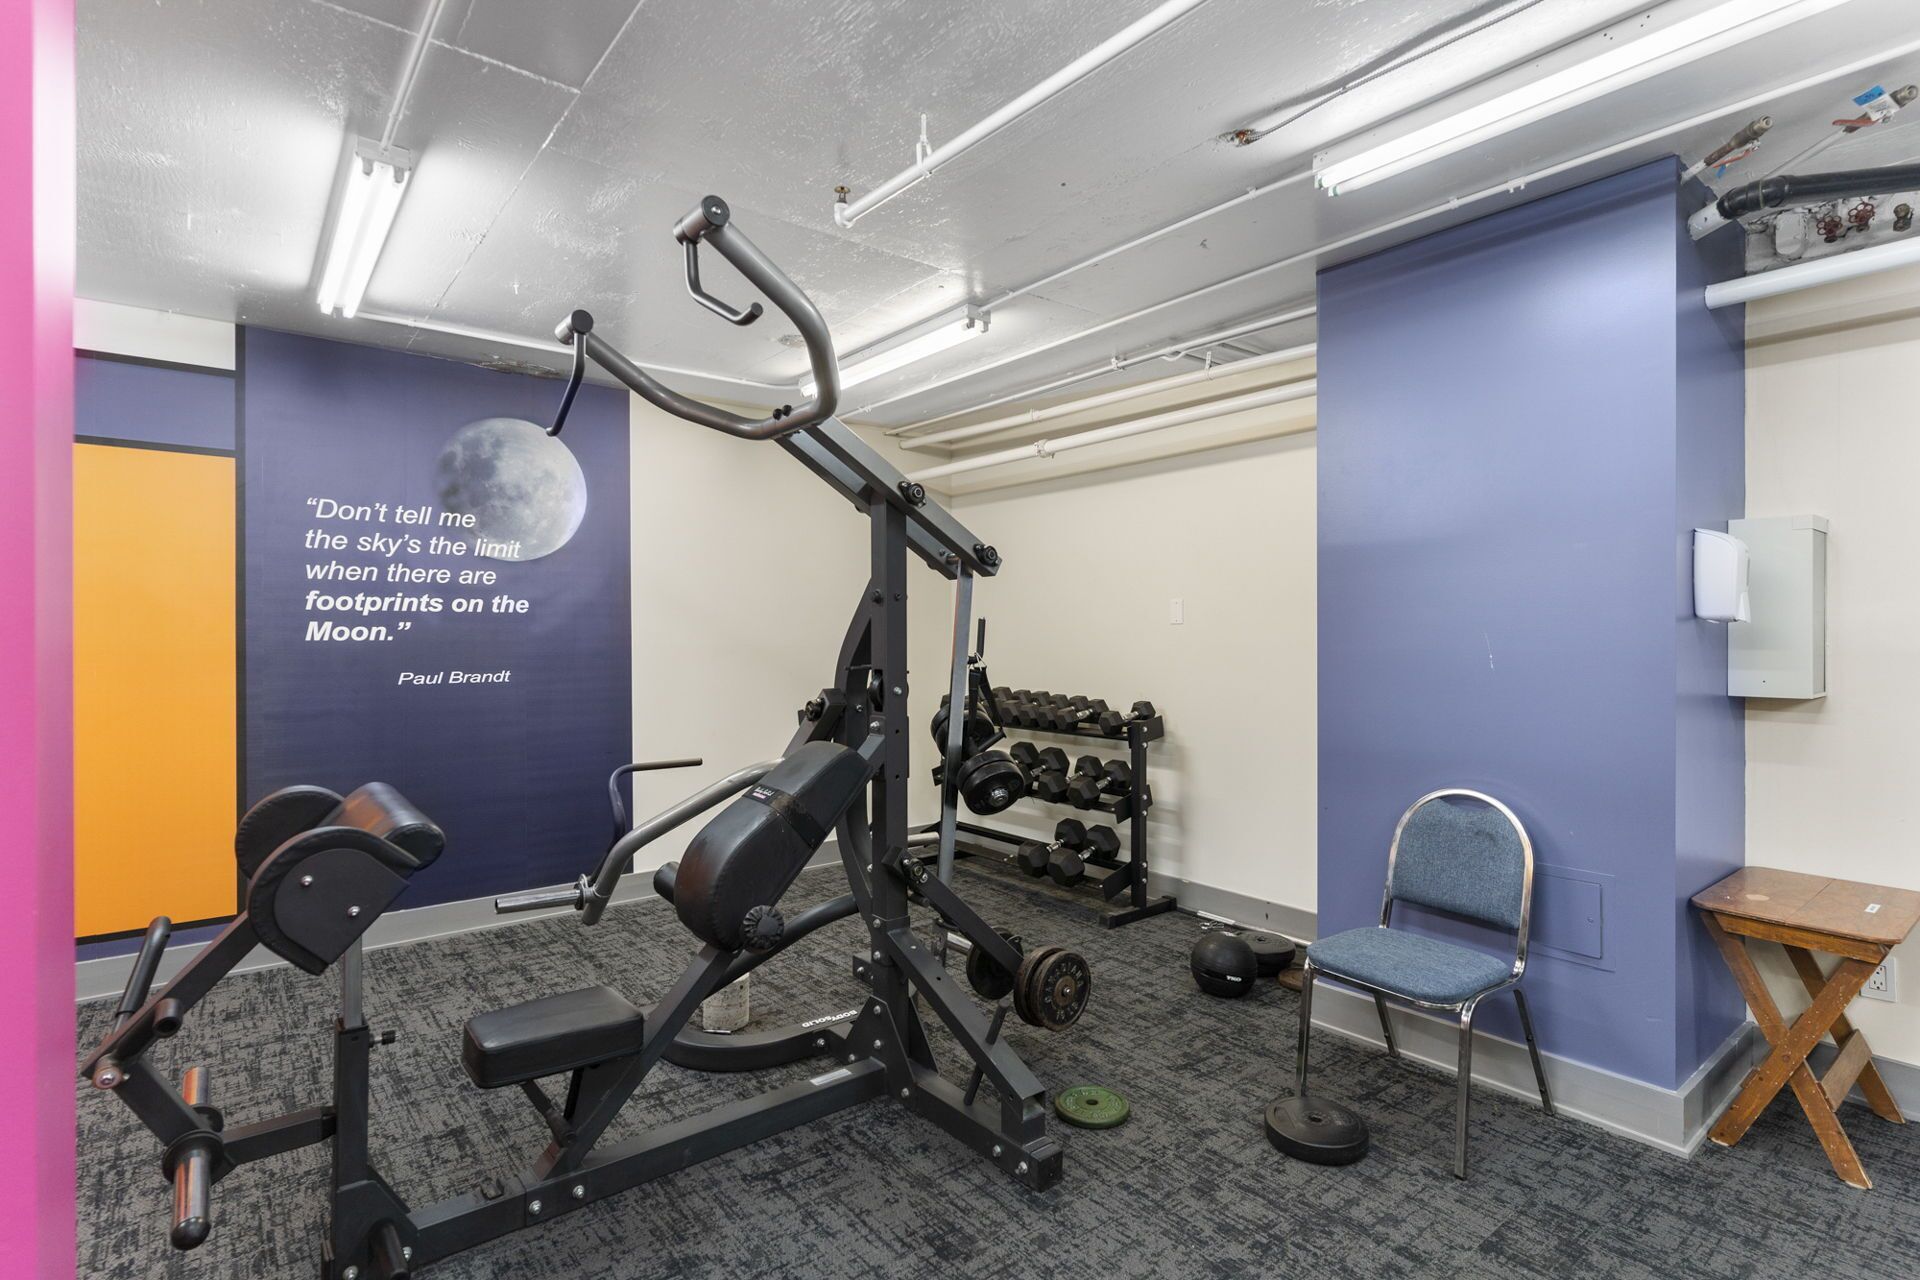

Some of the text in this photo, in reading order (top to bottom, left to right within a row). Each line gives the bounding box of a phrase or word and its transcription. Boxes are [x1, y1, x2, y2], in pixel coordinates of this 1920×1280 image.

[306, 497, 476, 528] “Don’t tell me
[304, 529, 522, 559] the sky’s the limit
[305, 560, 497, 585] when there are
[305, 590, 529, 615] footprints on the
[305, 621, 412, 641] Moon.”
[397, 670, 511, 685] Paul Brandt
